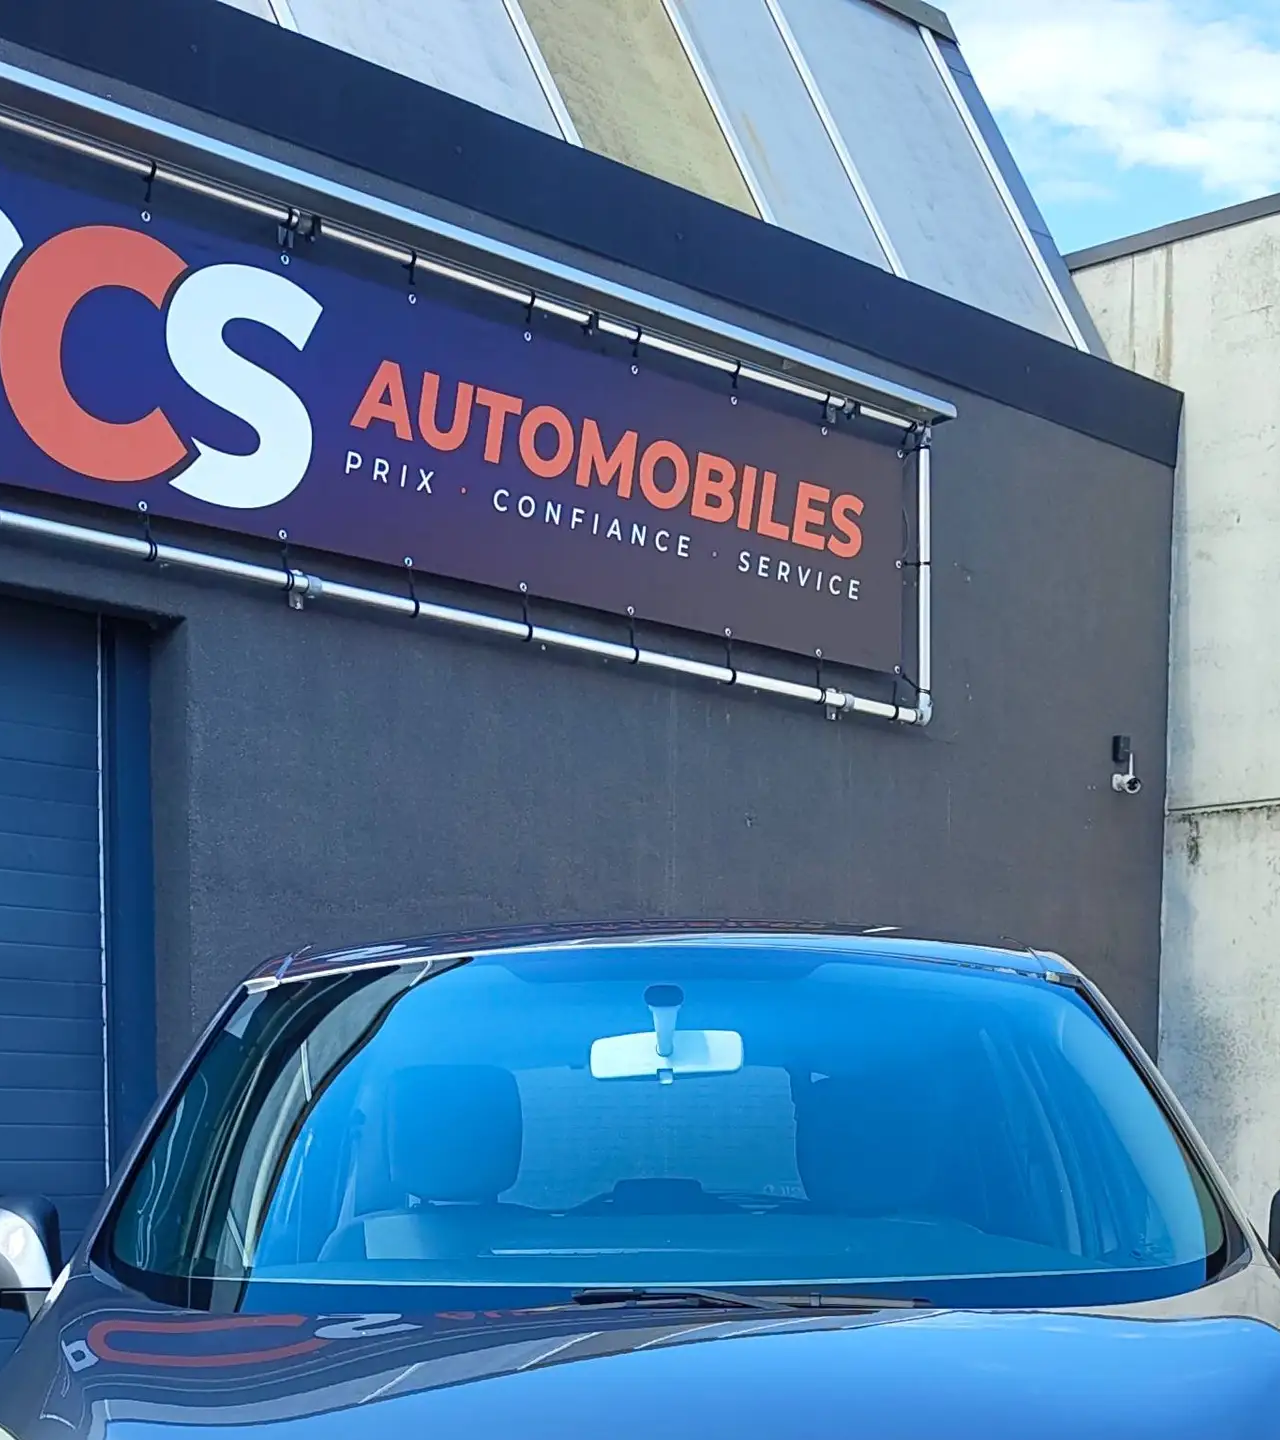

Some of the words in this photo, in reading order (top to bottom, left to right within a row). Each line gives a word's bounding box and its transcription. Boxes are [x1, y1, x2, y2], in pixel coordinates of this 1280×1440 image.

[344, 450, 436, 495] PRIX
[492, 489, 693, 558] CONFIANCE
[737, 551, 863, 601] SERVICE
[350, 359, 865, 558] AUTOMOBILES
